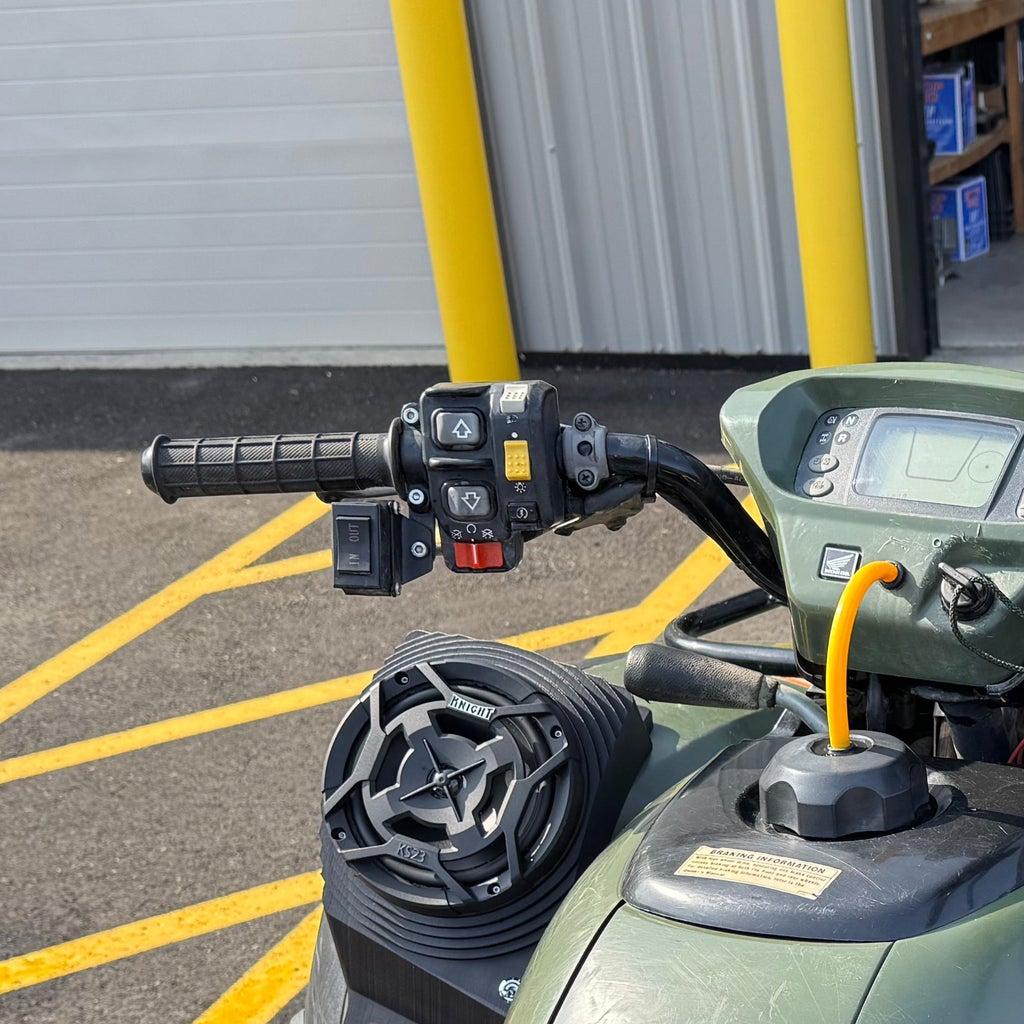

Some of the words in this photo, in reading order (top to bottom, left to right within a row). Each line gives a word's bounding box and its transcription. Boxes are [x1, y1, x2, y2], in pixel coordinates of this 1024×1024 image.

[846, 416, 856, 425] N
[837, 434, 847, 443] R
[348, 523, 360, 542] OUT
[348, 553, 360, 568] IN
[450, 694, 495, 719] KNIGHT
[397, 841, 426, 863] KS23
[709, 849, 755, 860] BRAKING
[756, 854, 827, 874] INFORMATION
